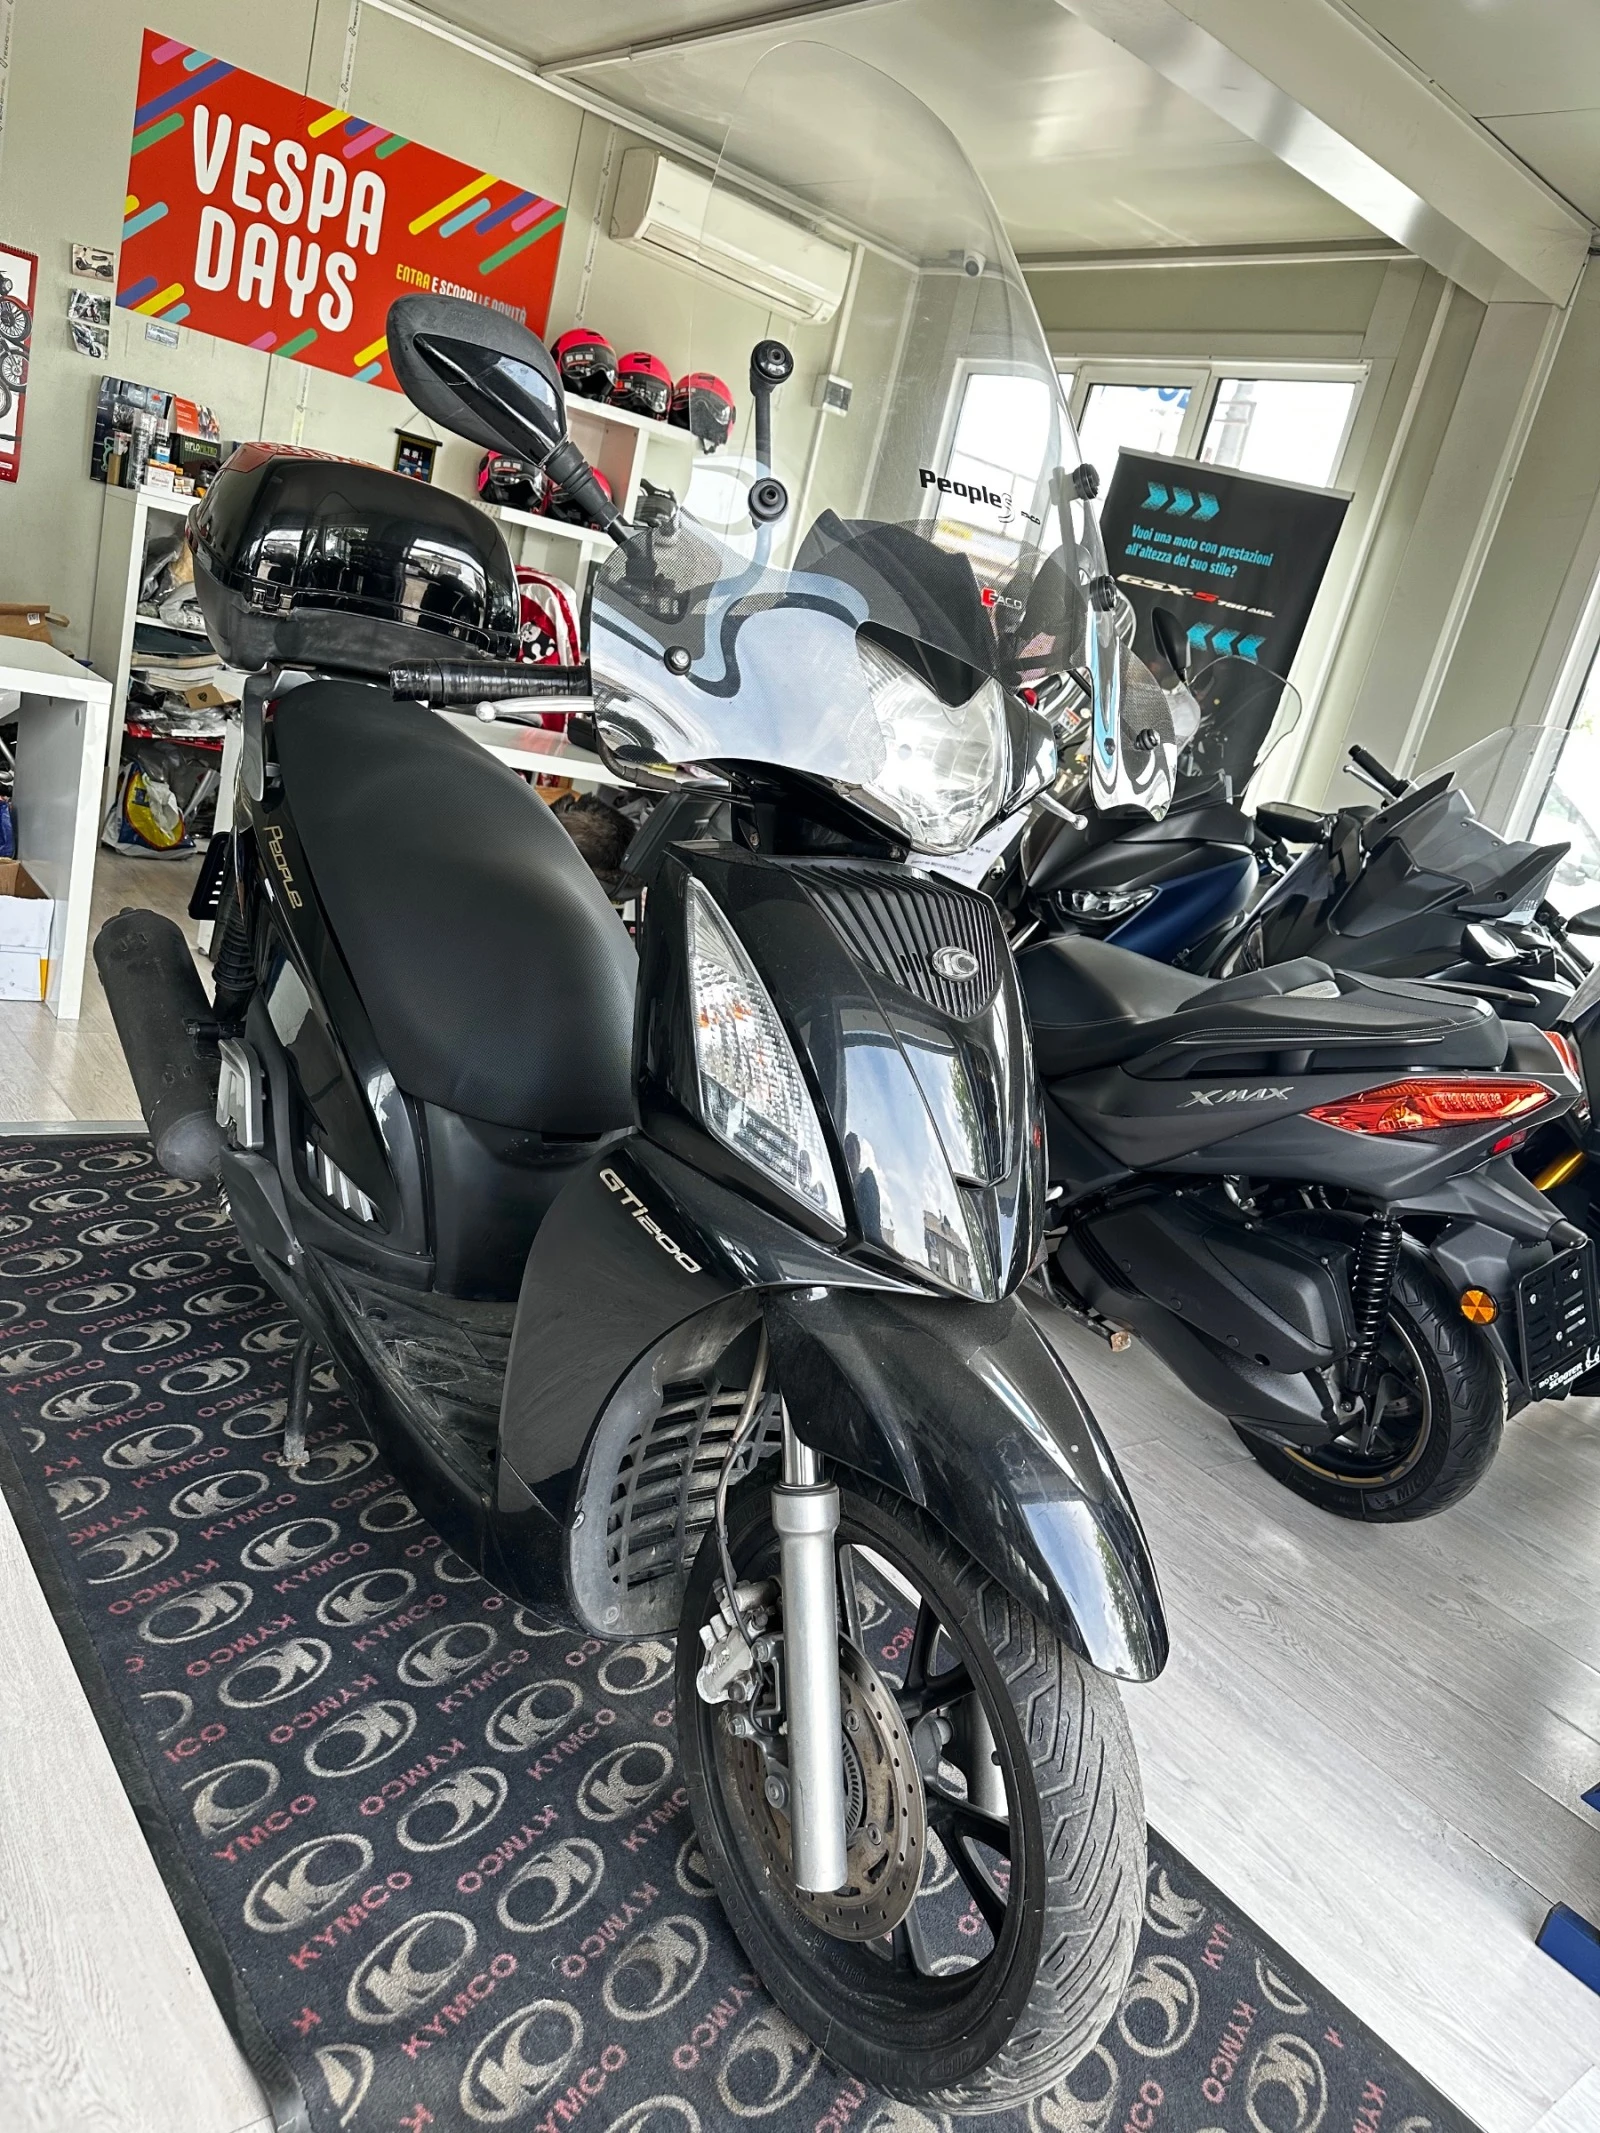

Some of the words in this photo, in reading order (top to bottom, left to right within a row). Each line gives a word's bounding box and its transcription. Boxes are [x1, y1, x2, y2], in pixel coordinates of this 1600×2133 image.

[193, 104, 386, 256] VESPA
[194, 205, 358, 333] DAYS
[396, 263, 431, 290] ENTRA
[431, 276, 440, 294] E
[1131, 523, 1153, 541] Vuoi
[1154, 531, 1172, 544] una
[1173, 536, 1198, 550] moto
[1199, 541, 1218, 554] con
[1218, 545, 1274, 567] prestazioni
[1173, 553, 1189, 568] del
[1189, 558, 1208, 572] suo
[1209, 563, 1238, 578] stile?
[2, 1174, 81, 1194] KYMCO
[50, 1204, 129, 1226] KYMCO
[100, 1236, 180, 1259] KYMCO
[24, 1269, 112, 1295] KYMCO
[152, 1268, 232, 1294] KYMCO
[80, 1305, 167, 1334] KYMCO
[208, 1302, 288, 1330] KYMCO
[6, 1360, 106, 1394] KYMCO
[137, 1341, 224, 1373] KYMCO
[66, 1402, 165, 1441] KYMCO
[198, 1381, 286, 1417] KYMCO
[130, 1446, 230, 1489] KYMCO
[200, 1493, 297, 1541] KYMCO
[108, 1559, 219, 1615] KYMCO
[273, 1542, 369, 1594] KYMCO
[186, 1614, 296, 1677] KYMCO
[353, 1594, 447, 1652] KYMCO
[438, 1650, 529, 1713] KYMCO
[270, 1674, 377, 1744] KYMCO
[527, 1709, 616, 1780] KYMCO
[360, 1739, 465, 1815] KYMCO
[457, 1806, 557, 1893] KYMCO
[289, 1872, 411, 1970] KYMCO
[559, 1882, 659, 1978] KYMCO
[401, 1954, 517, 2058] KYMCO
[1202, 2000, 1256, 2103] KYMCO
